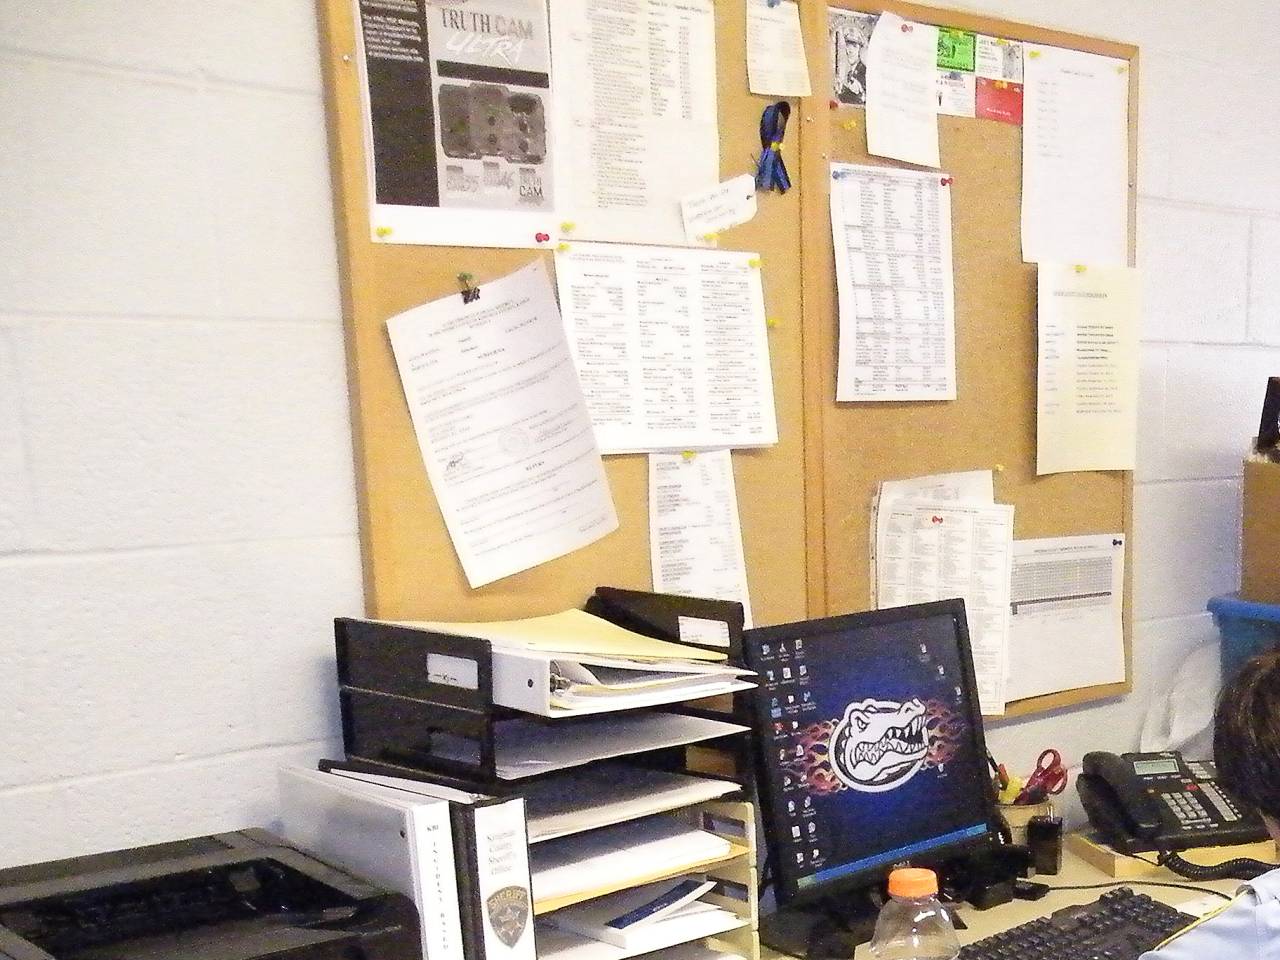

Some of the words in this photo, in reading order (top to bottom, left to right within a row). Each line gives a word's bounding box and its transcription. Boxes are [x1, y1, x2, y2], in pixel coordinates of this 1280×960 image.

[441, 7, 490, 33] TRUTH
[495, 15, 533, 40] CAM
[489, 888, 526, 910] SHERIFF
